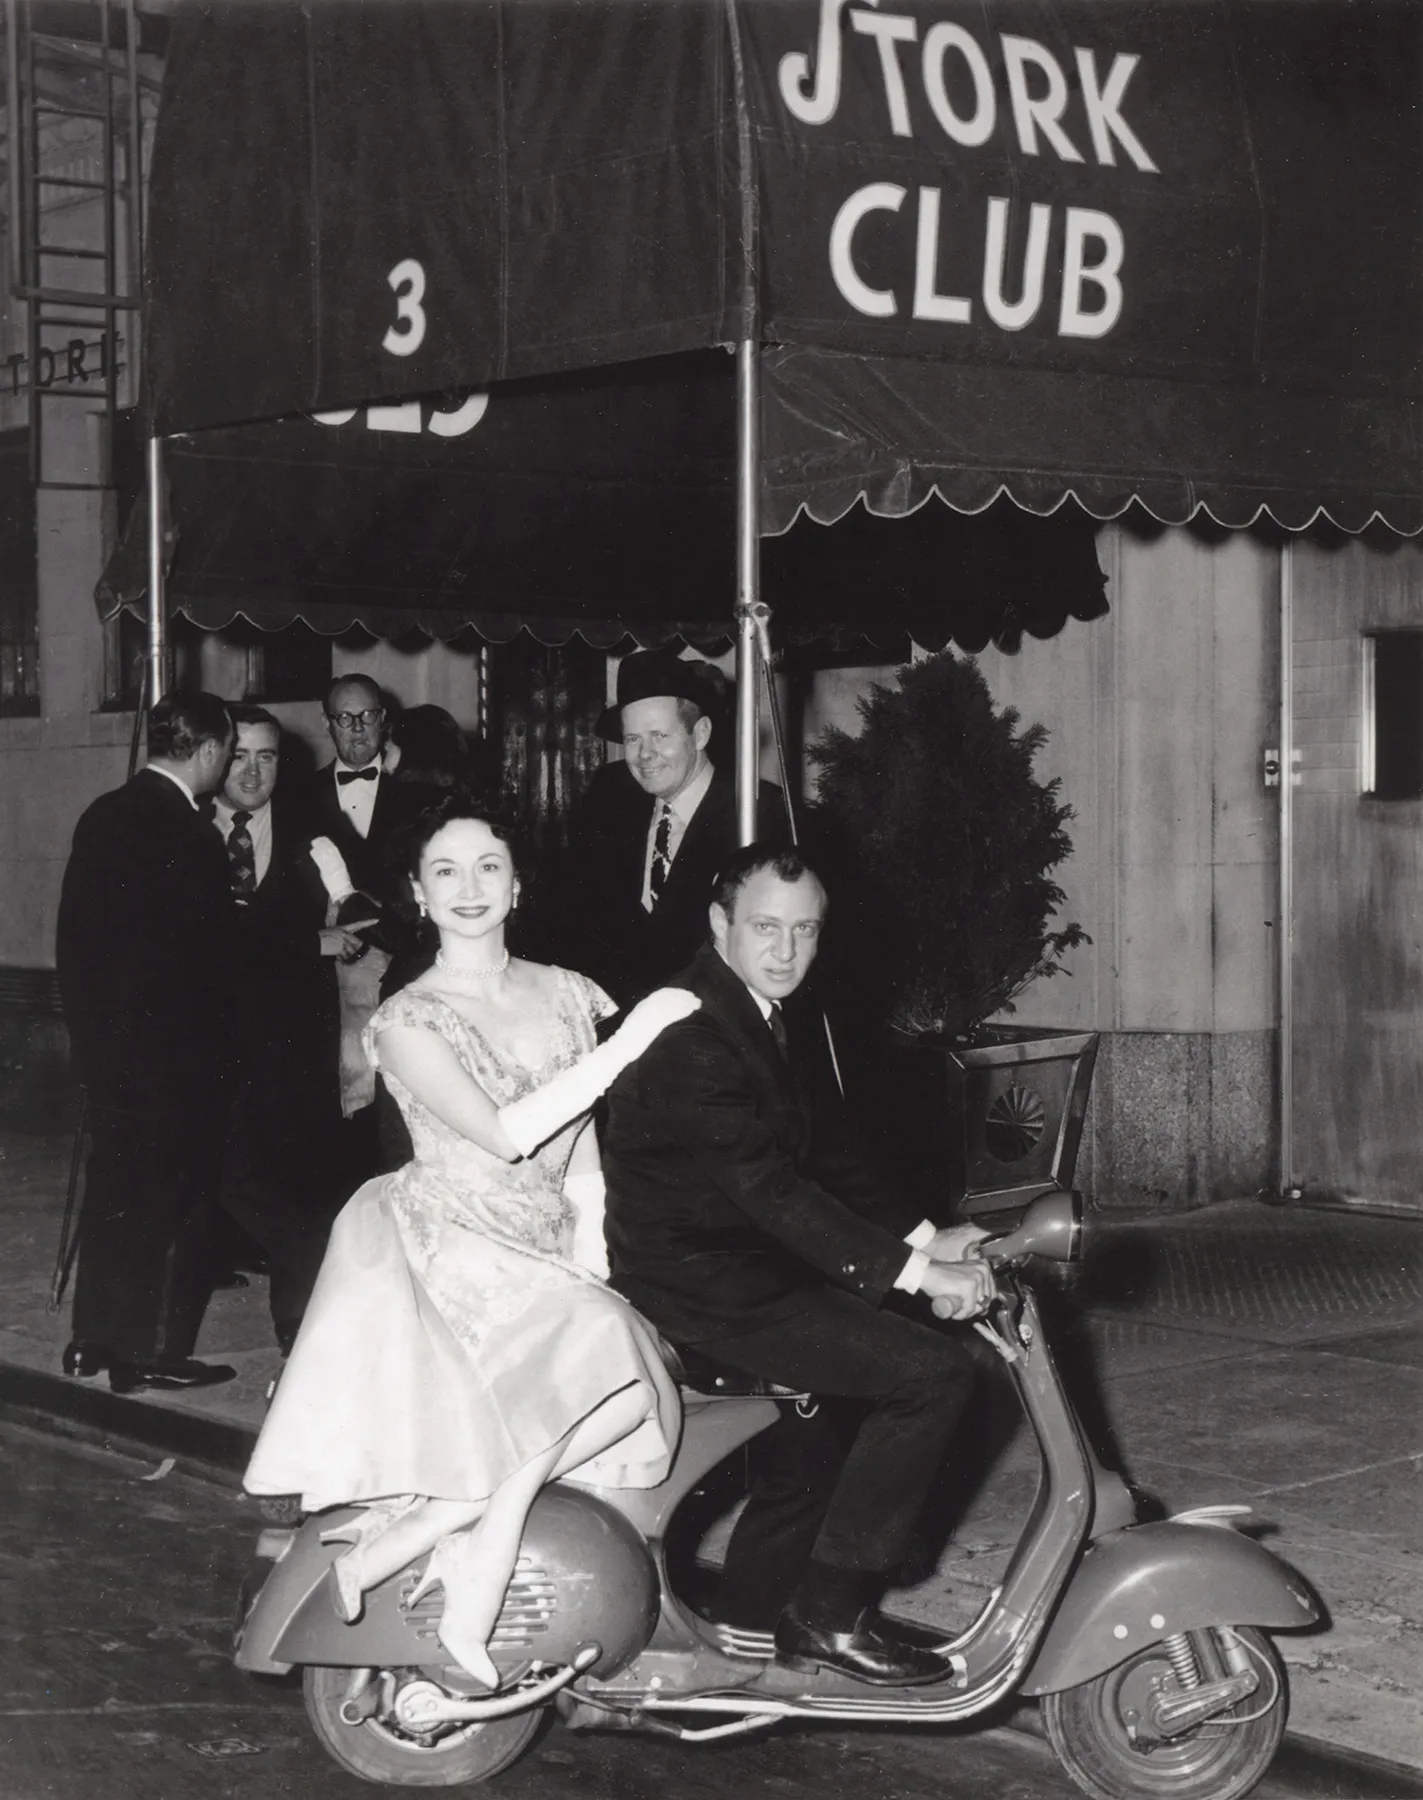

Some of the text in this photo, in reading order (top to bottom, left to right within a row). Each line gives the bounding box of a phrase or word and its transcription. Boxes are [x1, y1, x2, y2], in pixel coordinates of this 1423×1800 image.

[778, 0, 1160, 174] STORK
[381, 258, 427, 357] 3
[828, 182, 1126, 339] CLUB
